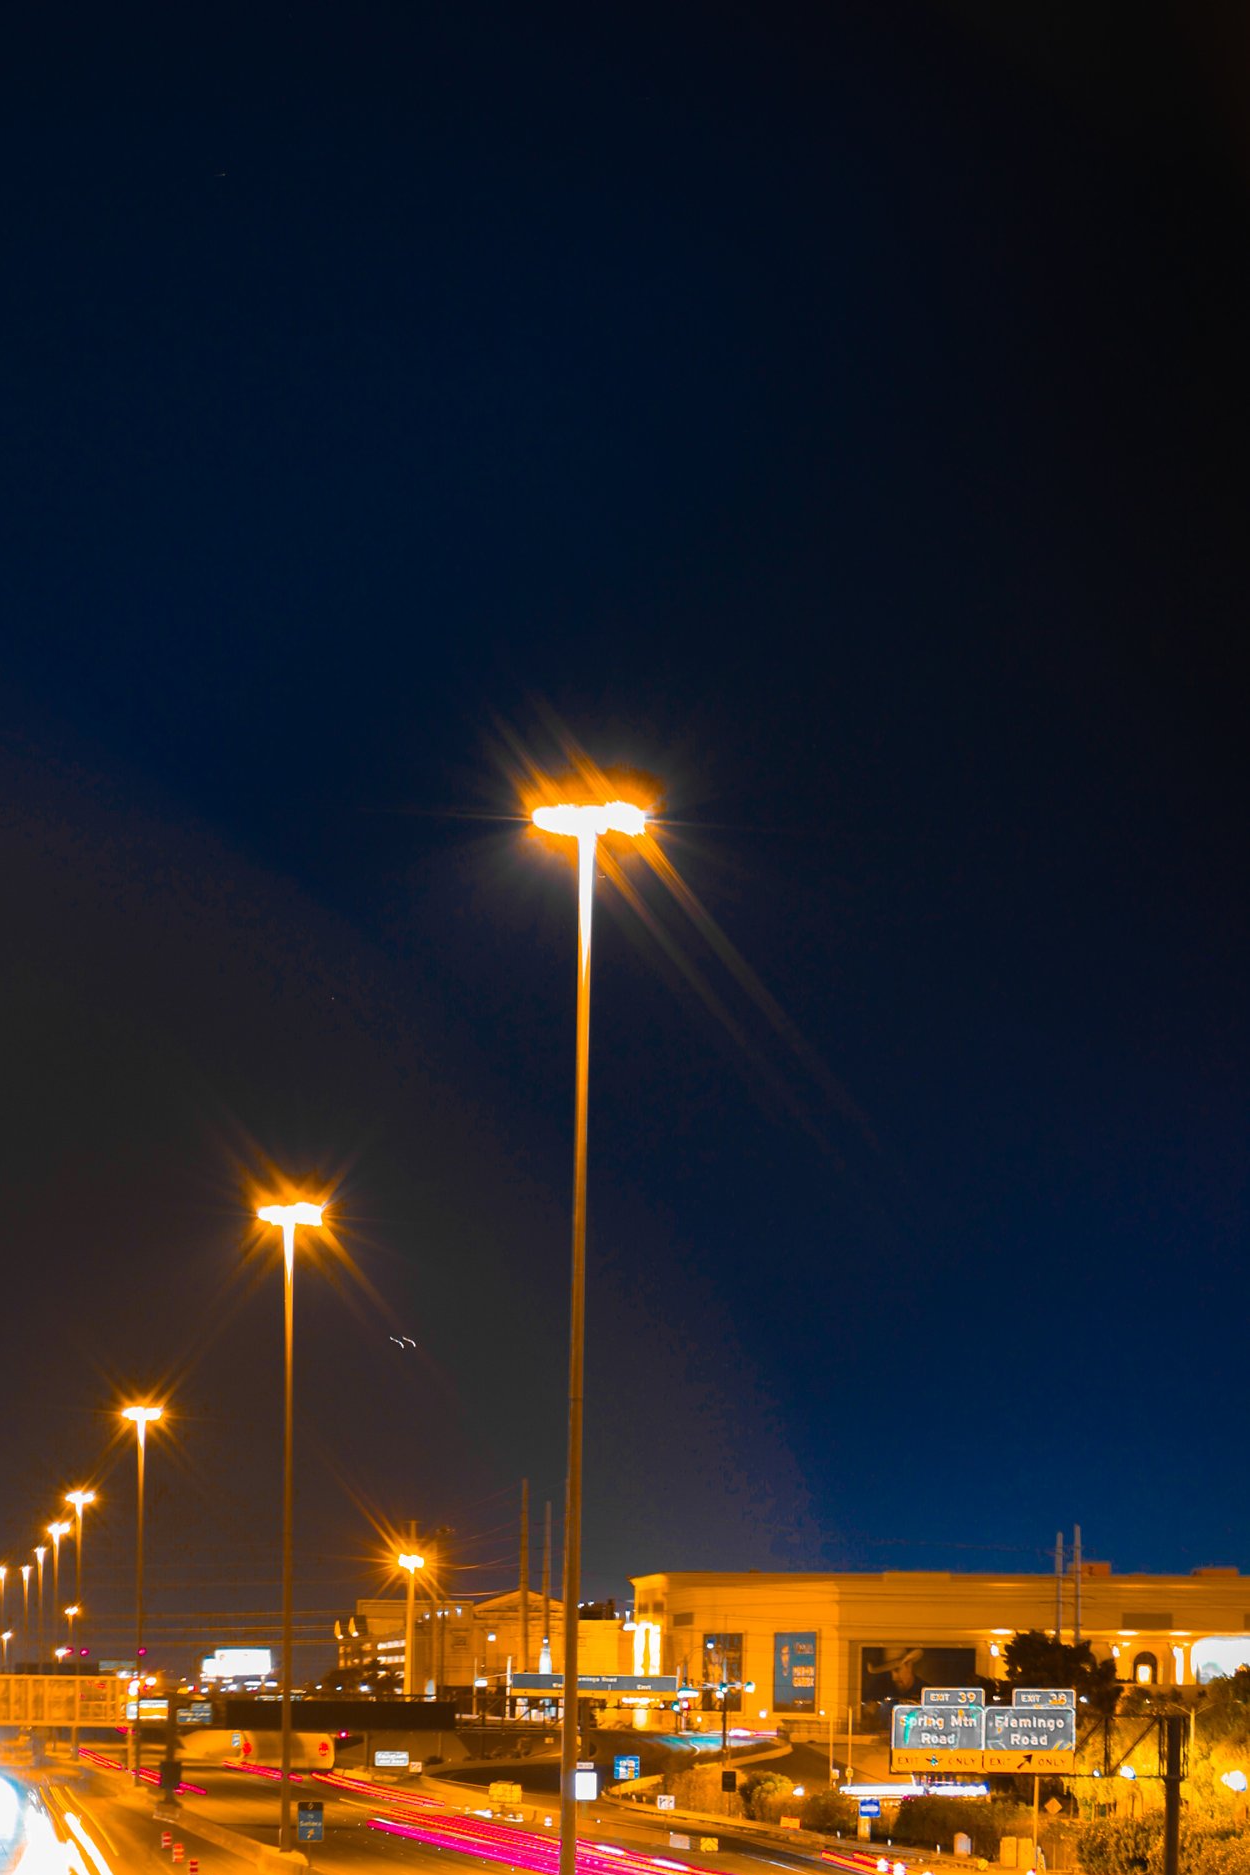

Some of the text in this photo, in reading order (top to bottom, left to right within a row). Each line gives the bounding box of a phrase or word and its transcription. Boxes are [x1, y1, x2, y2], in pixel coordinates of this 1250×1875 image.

[929, 1692, 977, 1703] EXIT 39
[1020, 1693, 1067, 1705] EXIT 38
[899, 1714, 977, 1730] Spring Mtn
[994, 1715, 1065, 1731] Flamingo
[921, 1732, 956, 1744] Road
[1010, 1734, 1048, 1745] Road
[897, 1757, 977, 1765] EXIT ONLY
[990, 1758, 1066, 1766] EXIT ONLY
